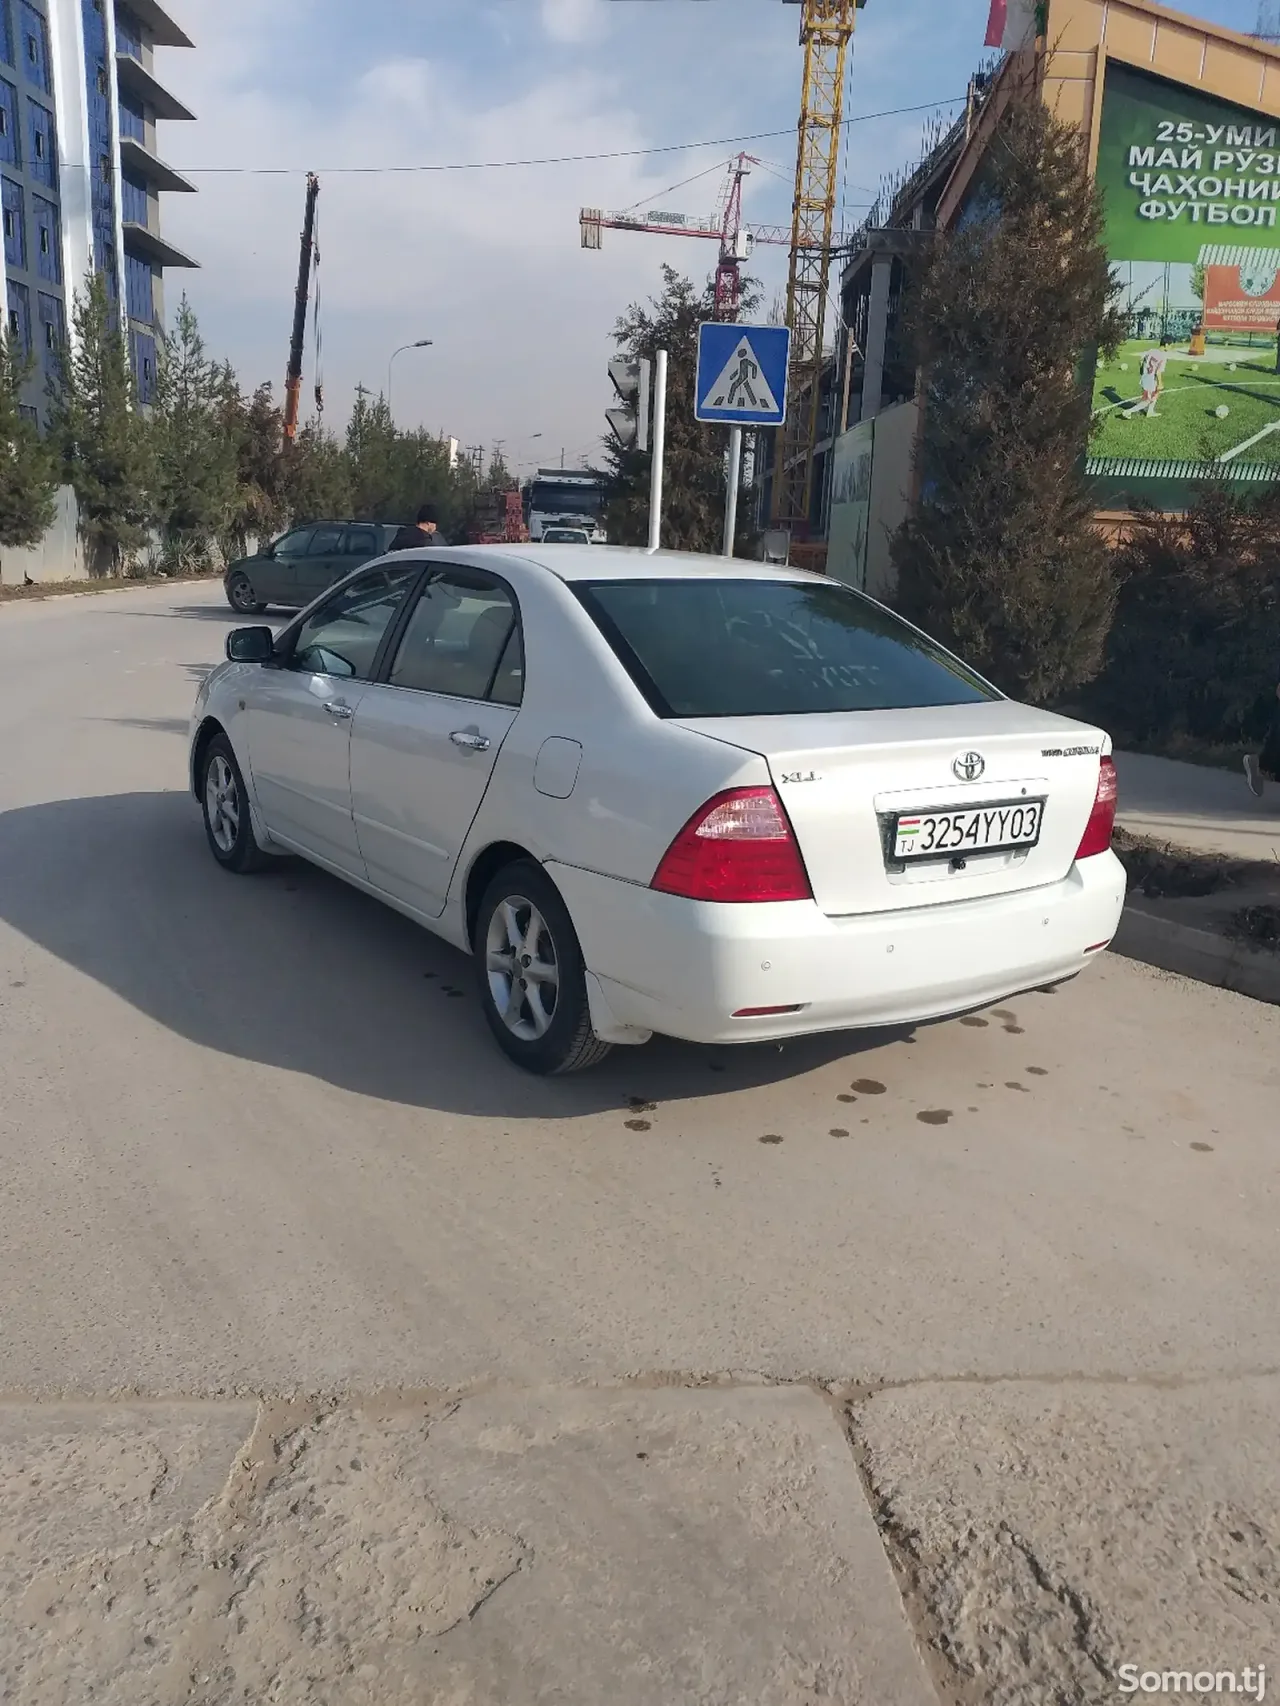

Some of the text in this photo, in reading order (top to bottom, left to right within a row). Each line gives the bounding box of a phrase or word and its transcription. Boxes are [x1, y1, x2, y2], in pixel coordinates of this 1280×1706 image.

[1156, 121, 1276, 147] 25-УМИ
[1129, 144, 1280, 174] МАЙ РӮЗ
[1139, 200, 1277, 227] ФУТБОЛ
[920, 807, 1037, 850] 3254YY03
[901, 839, 915, 853] TJ
